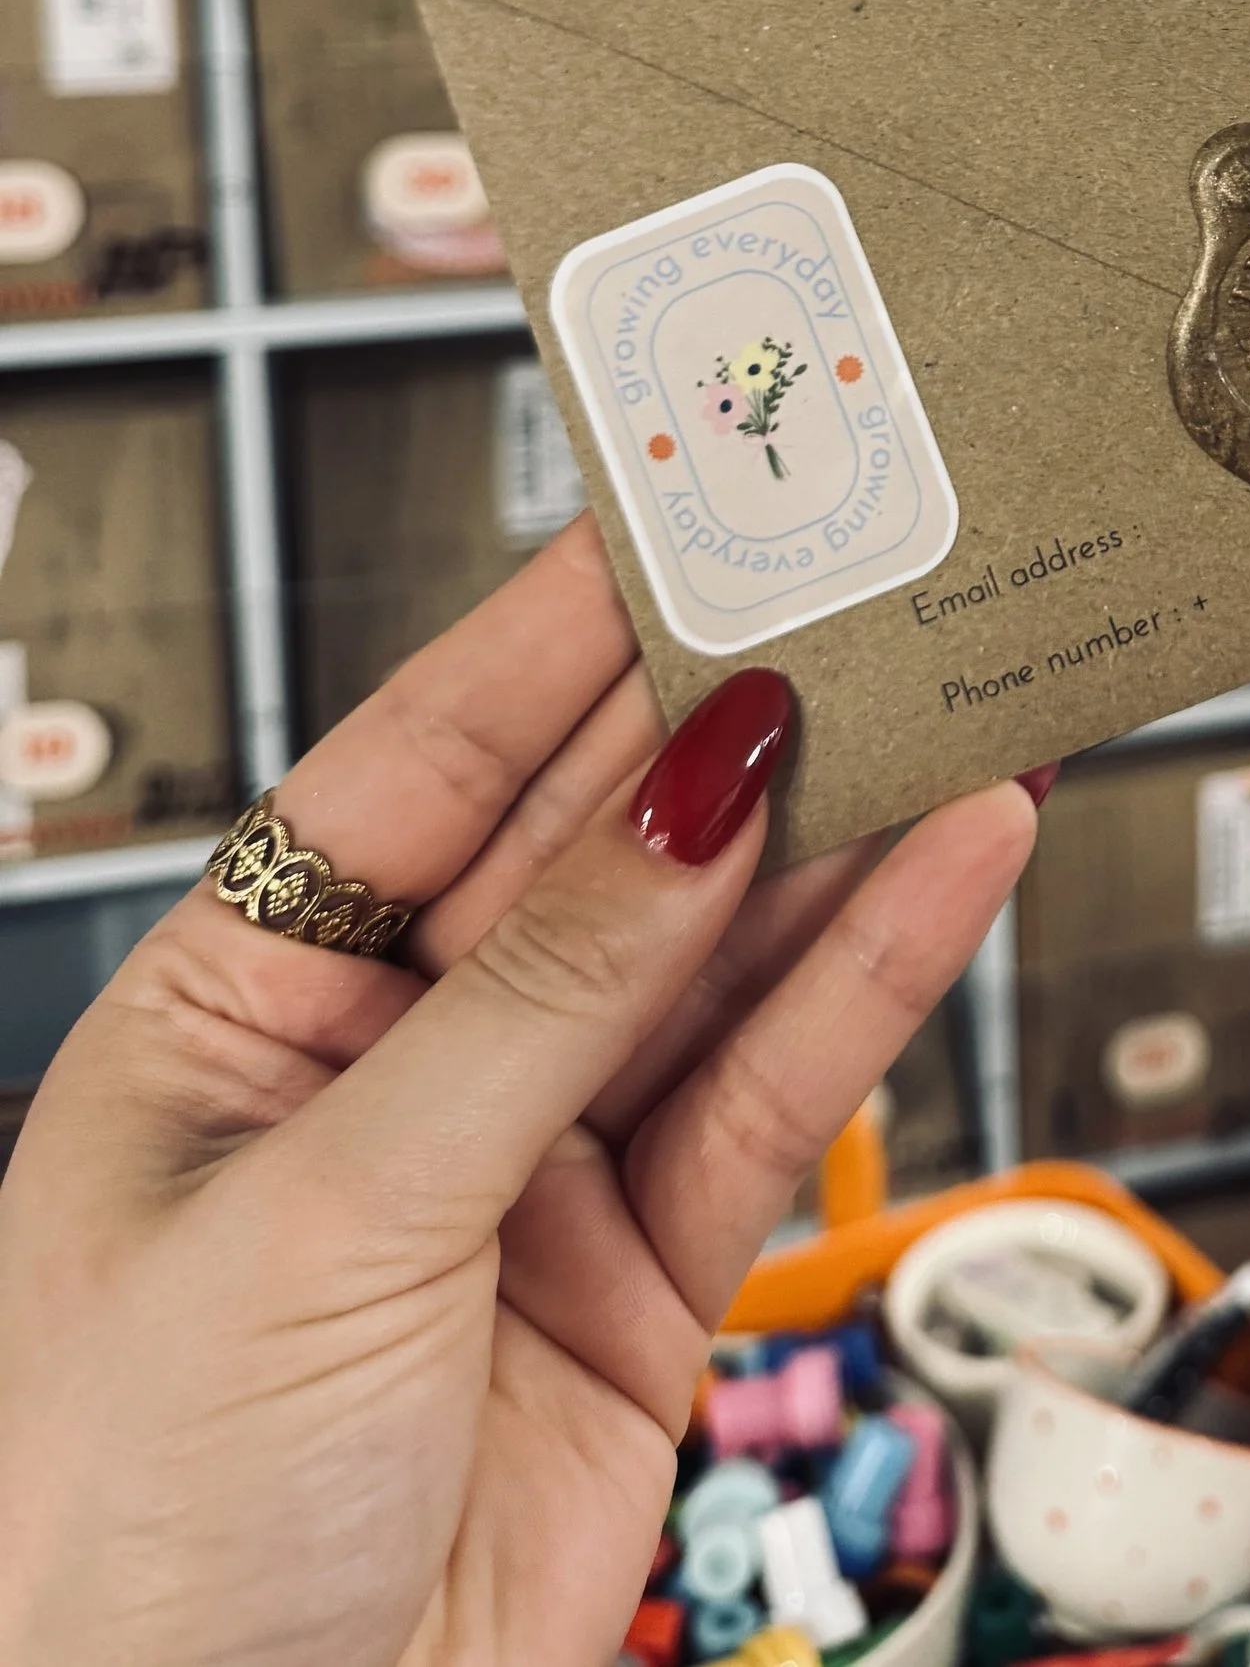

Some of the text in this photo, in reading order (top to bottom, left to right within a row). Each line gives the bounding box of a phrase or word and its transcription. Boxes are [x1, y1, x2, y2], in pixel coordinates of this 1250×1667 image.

[613, 230, 850, 407] growing everyday
[662, 404, 891, 574] growing everyday
[910, 564, 1002, 626] Email
[1010, 529, 1124, 587] address
[940, 665, 1036, 713] Phone
[1046, 612, 1162, 675] number
